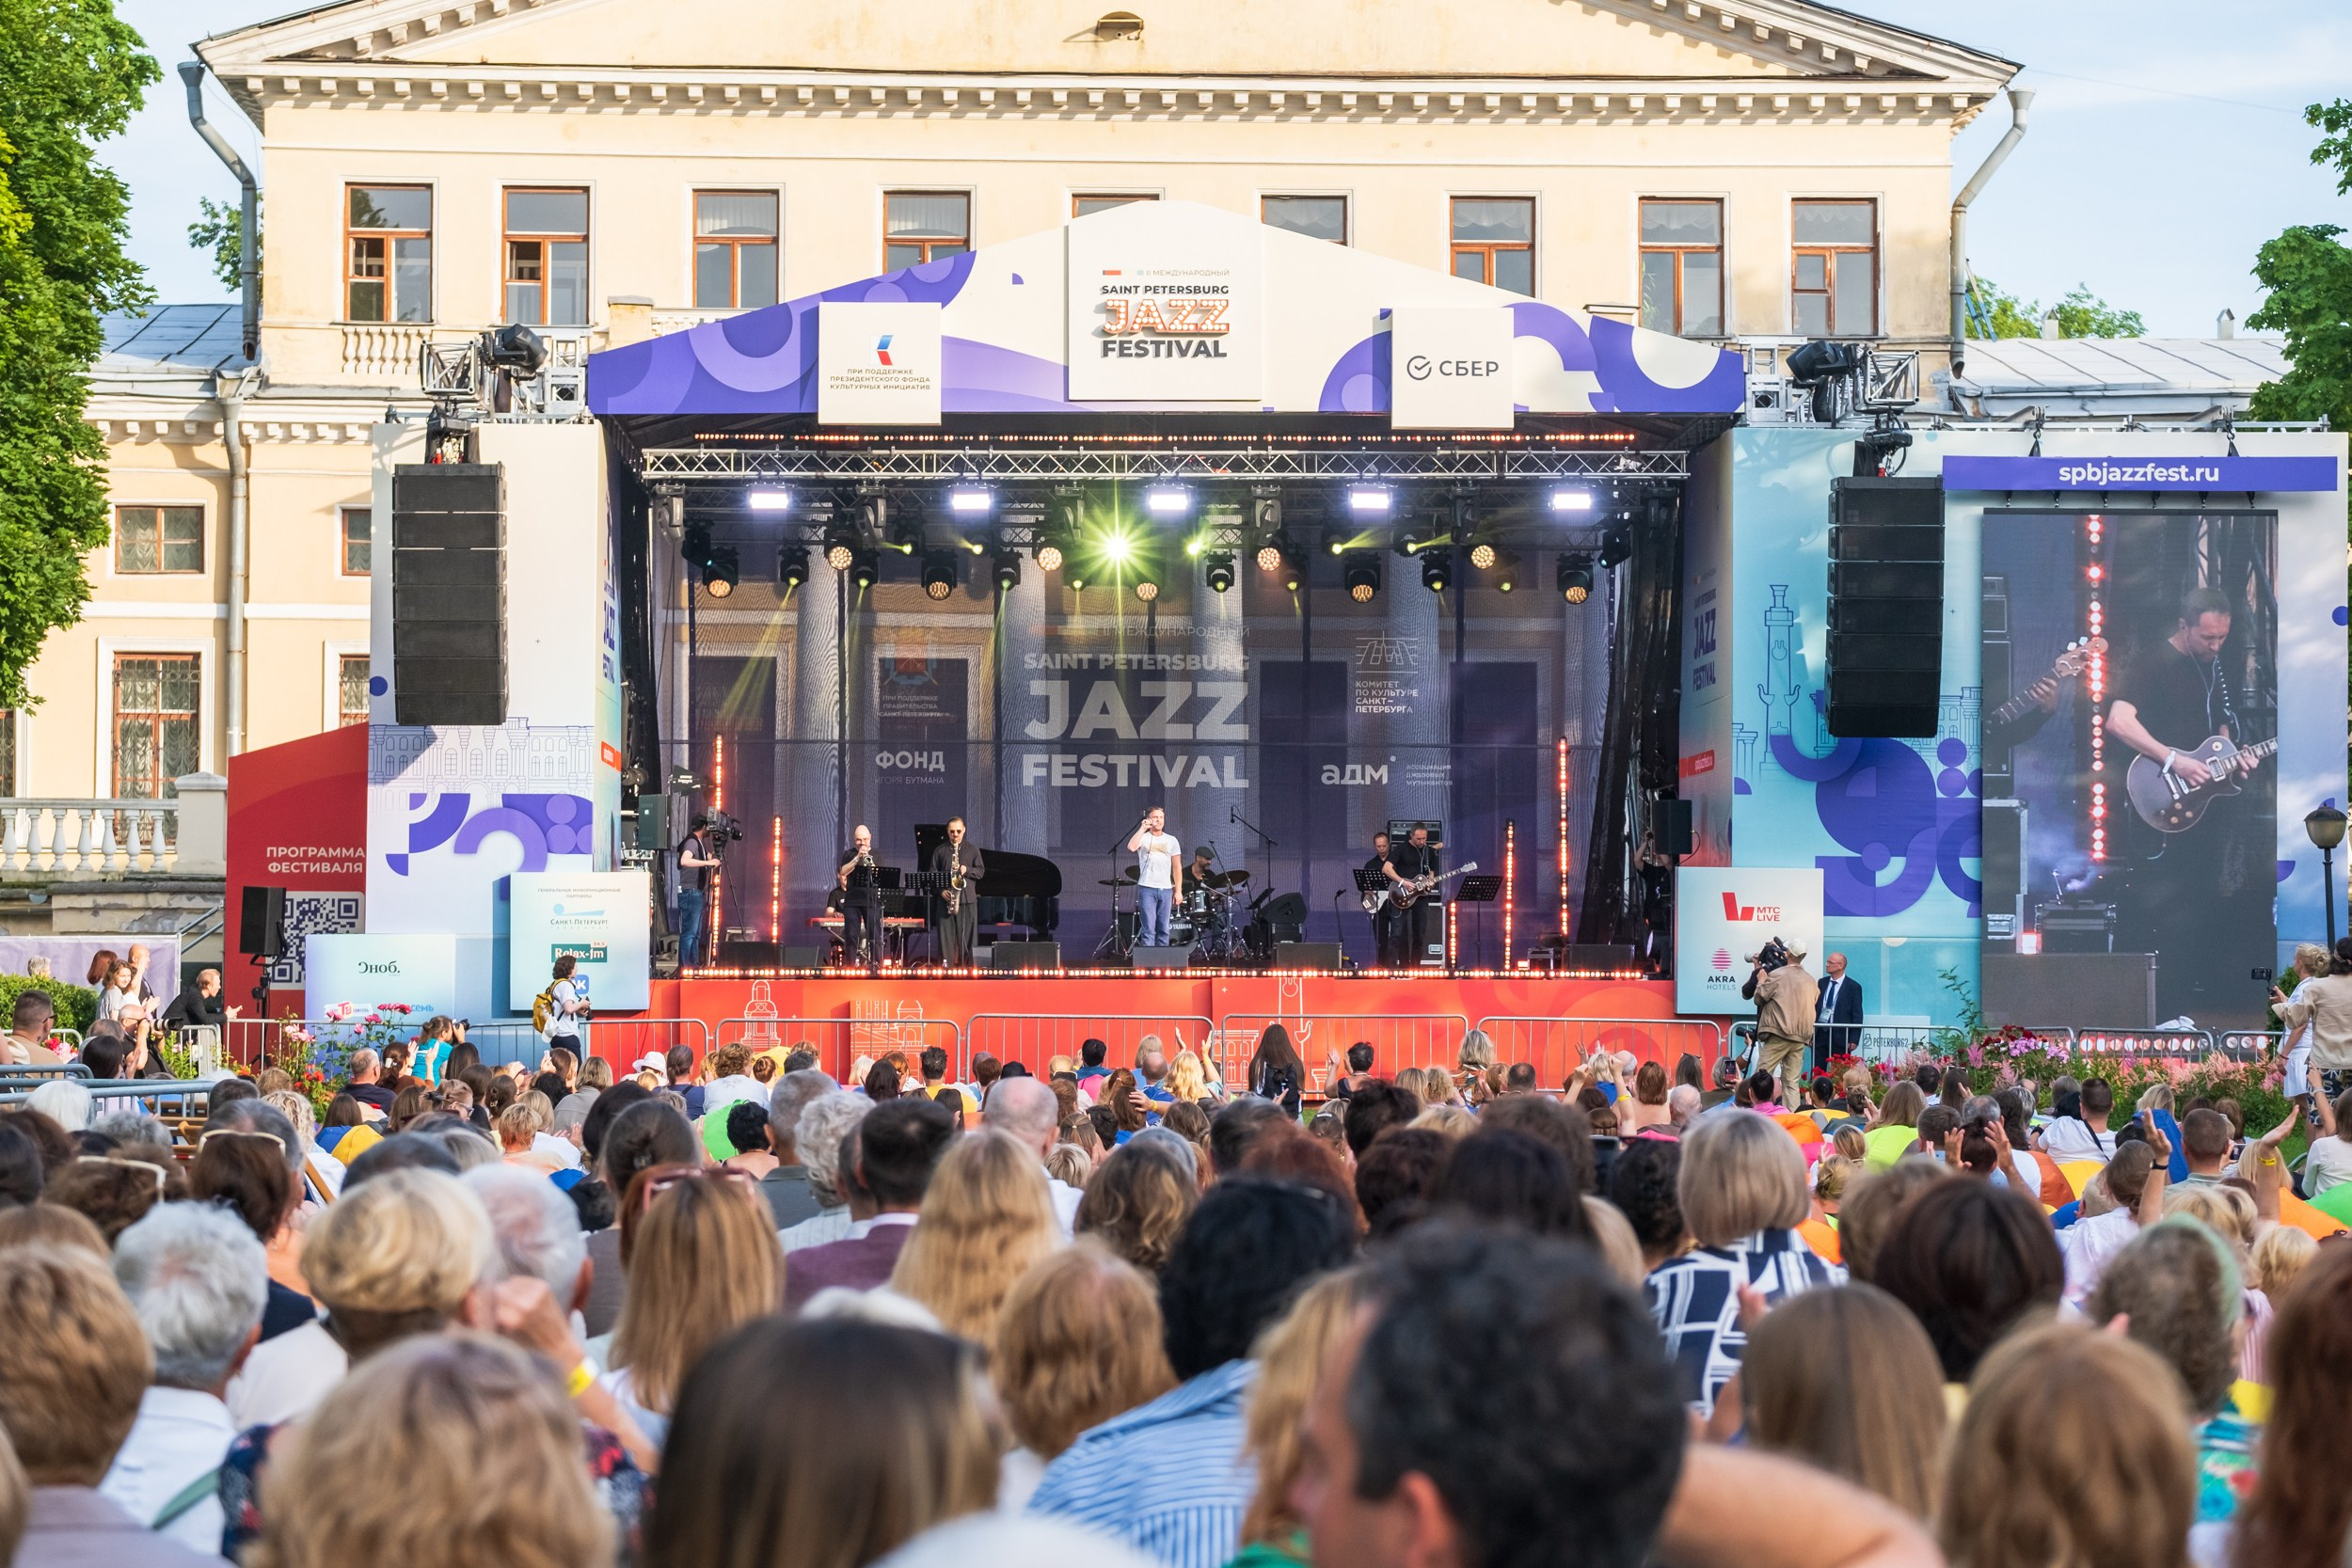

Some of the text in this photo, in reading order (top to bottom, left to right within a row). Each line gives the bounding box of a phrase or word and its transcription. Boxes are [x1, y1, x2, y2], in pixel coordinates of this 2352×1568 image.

[1101, 285, 1230, 294] SAINT PETERSBURG
[1103, 299, 1230, 335] JAZZ
[1102, 340, 1228, 357] FESTIVAL
[1439, 360, 1499, 376] СБЕР
[2058, 462, 2219, 485] spbjazzfest.ru
[1693, 608, 1716, 659] JAZZ
[1024, 654, 1250, 671] SAINT PETERSBURG
[1693, 660, 1716, 692] FESTIVAL
[1024, 680, 1249, 740] JAZZ
[875, 751, 946, 771] ФОНД
[1023, 754, 1249, 787] FESTIVAL
[266, 847, 366, 858] ПРОГРАММА
[268, 862, 363, 873] ФЕСТИВАЛЯ
[554, 947, 604, 959] Relax-fm
